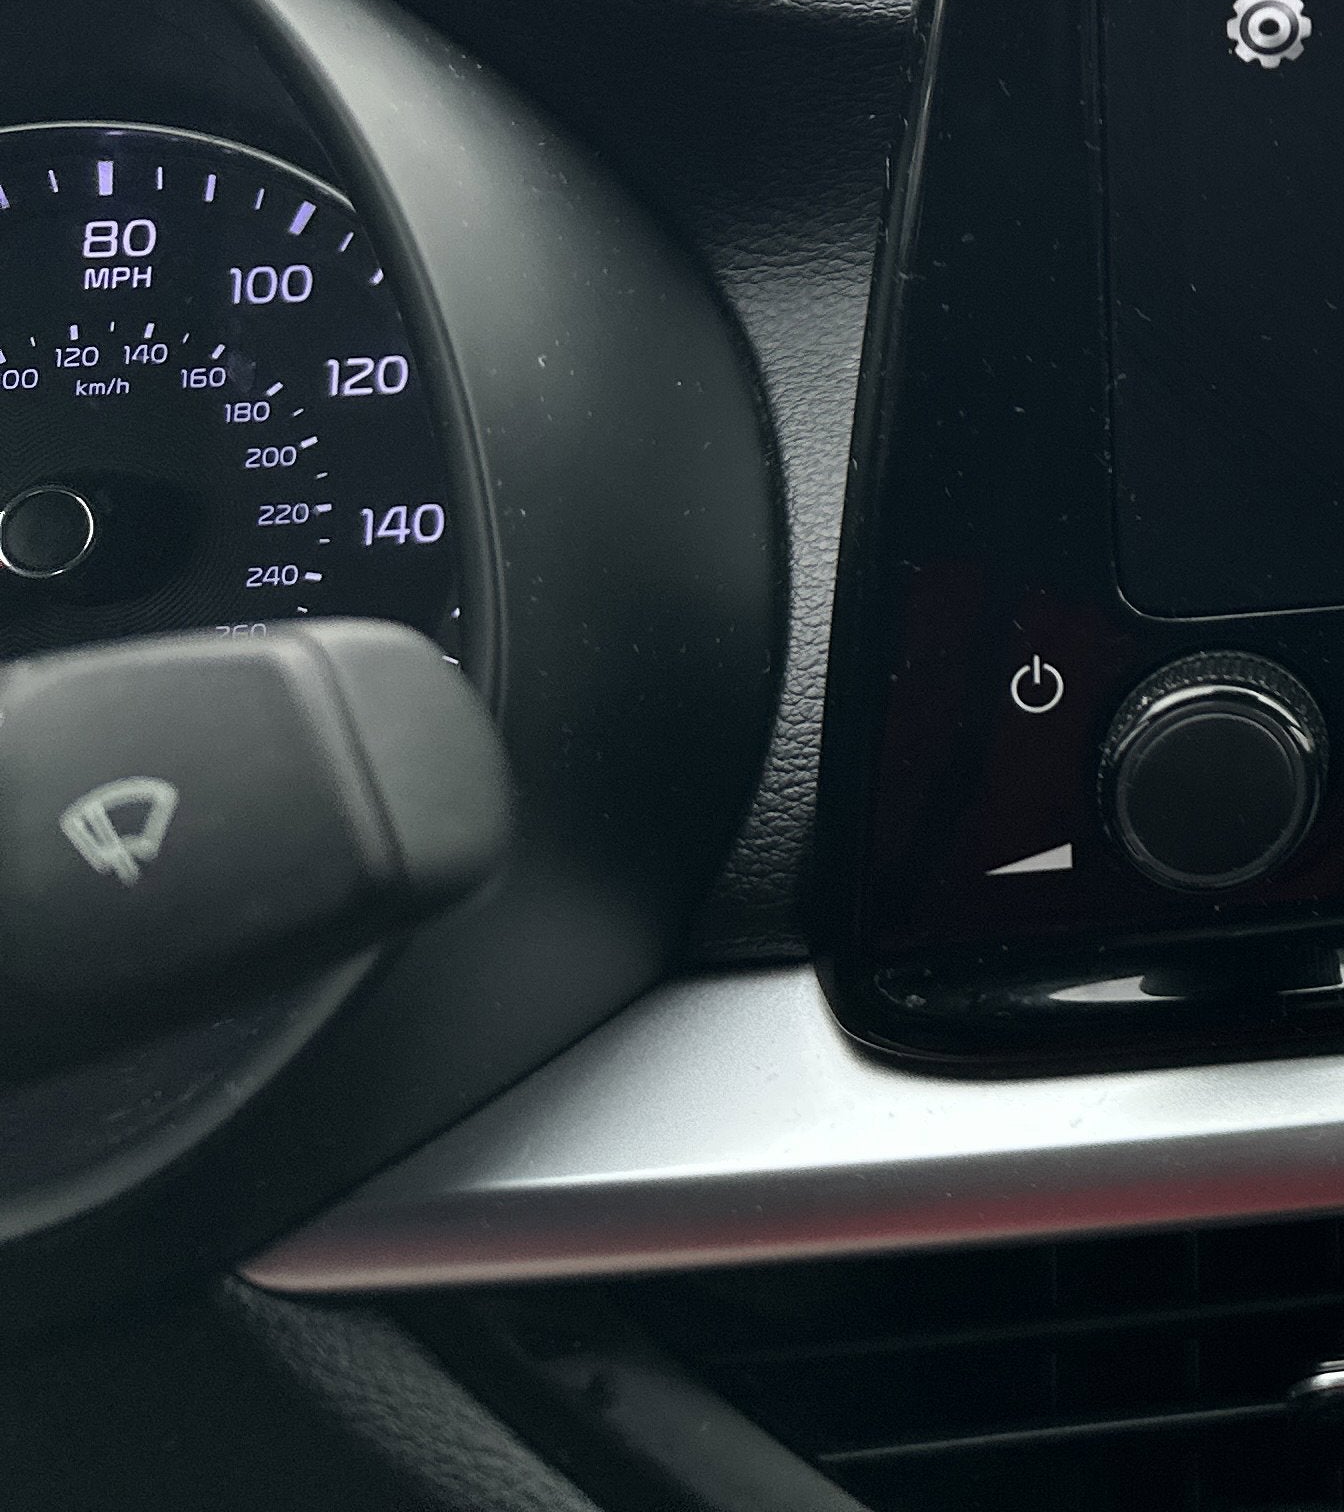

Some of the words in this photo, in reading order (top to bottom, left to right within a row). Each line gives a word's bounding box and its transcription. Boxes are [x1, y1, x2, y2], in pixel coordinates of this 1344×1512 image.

[82, 219, 157, 258] 80
[84, 266, 152, 290] MPH
[229, 264, 313, 305] 100
[55, 346, 99, 368] 120
[123, 344, 168, 365] 140
[0, 368, 39, 390] 00
[75, 377, 130, 396] km/h
[180, 367, 227, 388] 160
[327, 355, 410, 397] 120
[224, 401, 271, 423] 180
[245, 446, 298, 469] 200
[257, 503, 310, 526] 220
[361, 503, 445, 546] 140
[246, 564, 299, 588] 240
